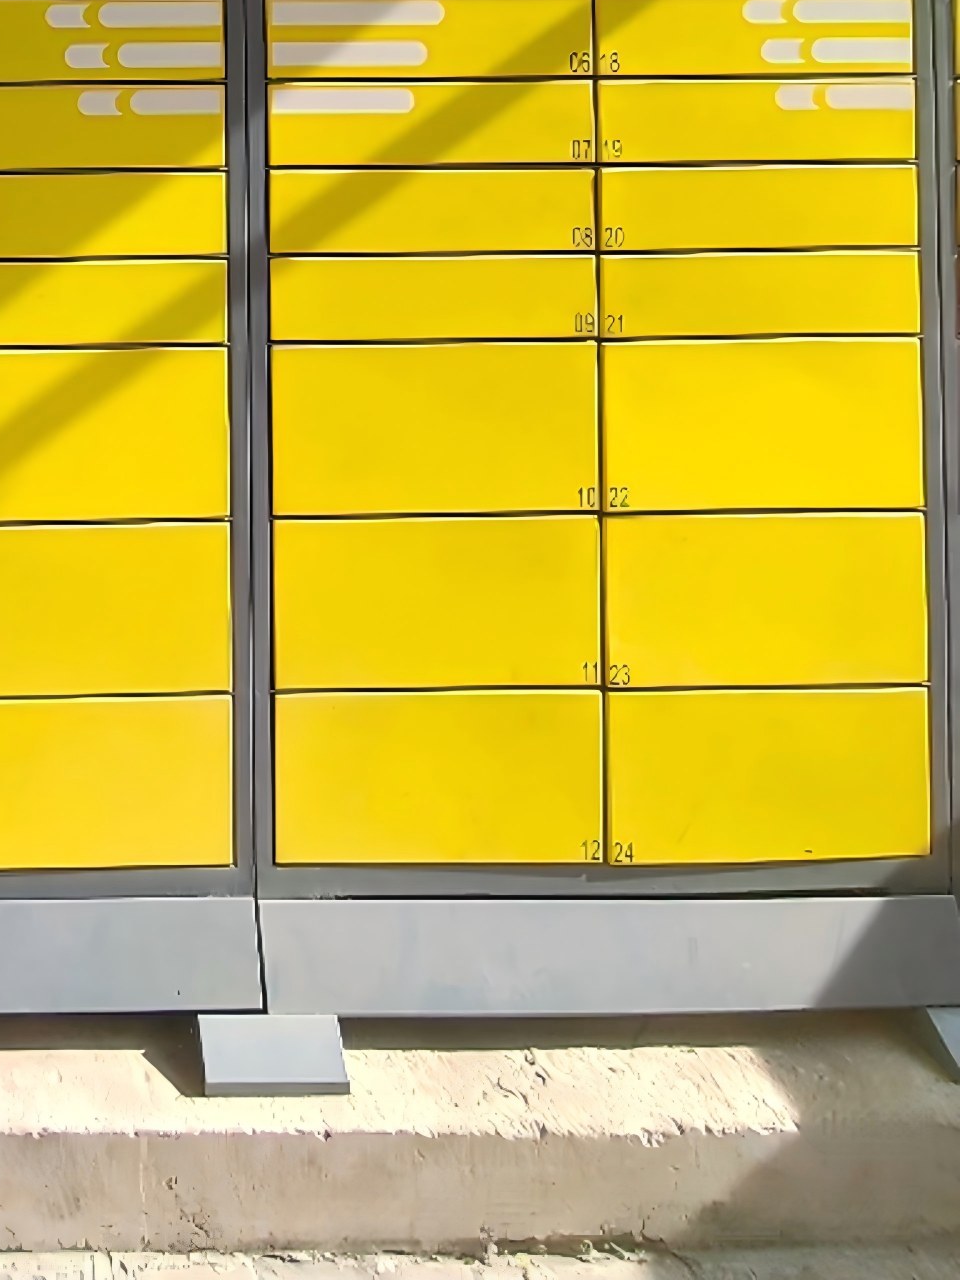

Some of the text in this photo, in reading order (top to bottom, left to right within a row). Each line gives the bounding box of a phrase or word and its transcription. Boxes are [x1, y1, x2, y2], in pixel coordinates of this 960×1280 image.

[569, 52, 590, 72] 06
[600, 52, 620, 72] 18
[572, 139, 591, 160] 07
[605, 227, 625, 247] 20
[574, 312, 594, 332] 09
[605, 314, 623, 334] 21
[578, 487, 595, 508] 10
[609, 486, 630, 508] 22
[583, 661, 598, 683] 11
[609, 665, 630, 685] 23
[581, 839, 600, 860] 12
[614, 842, 634, 863] 24
